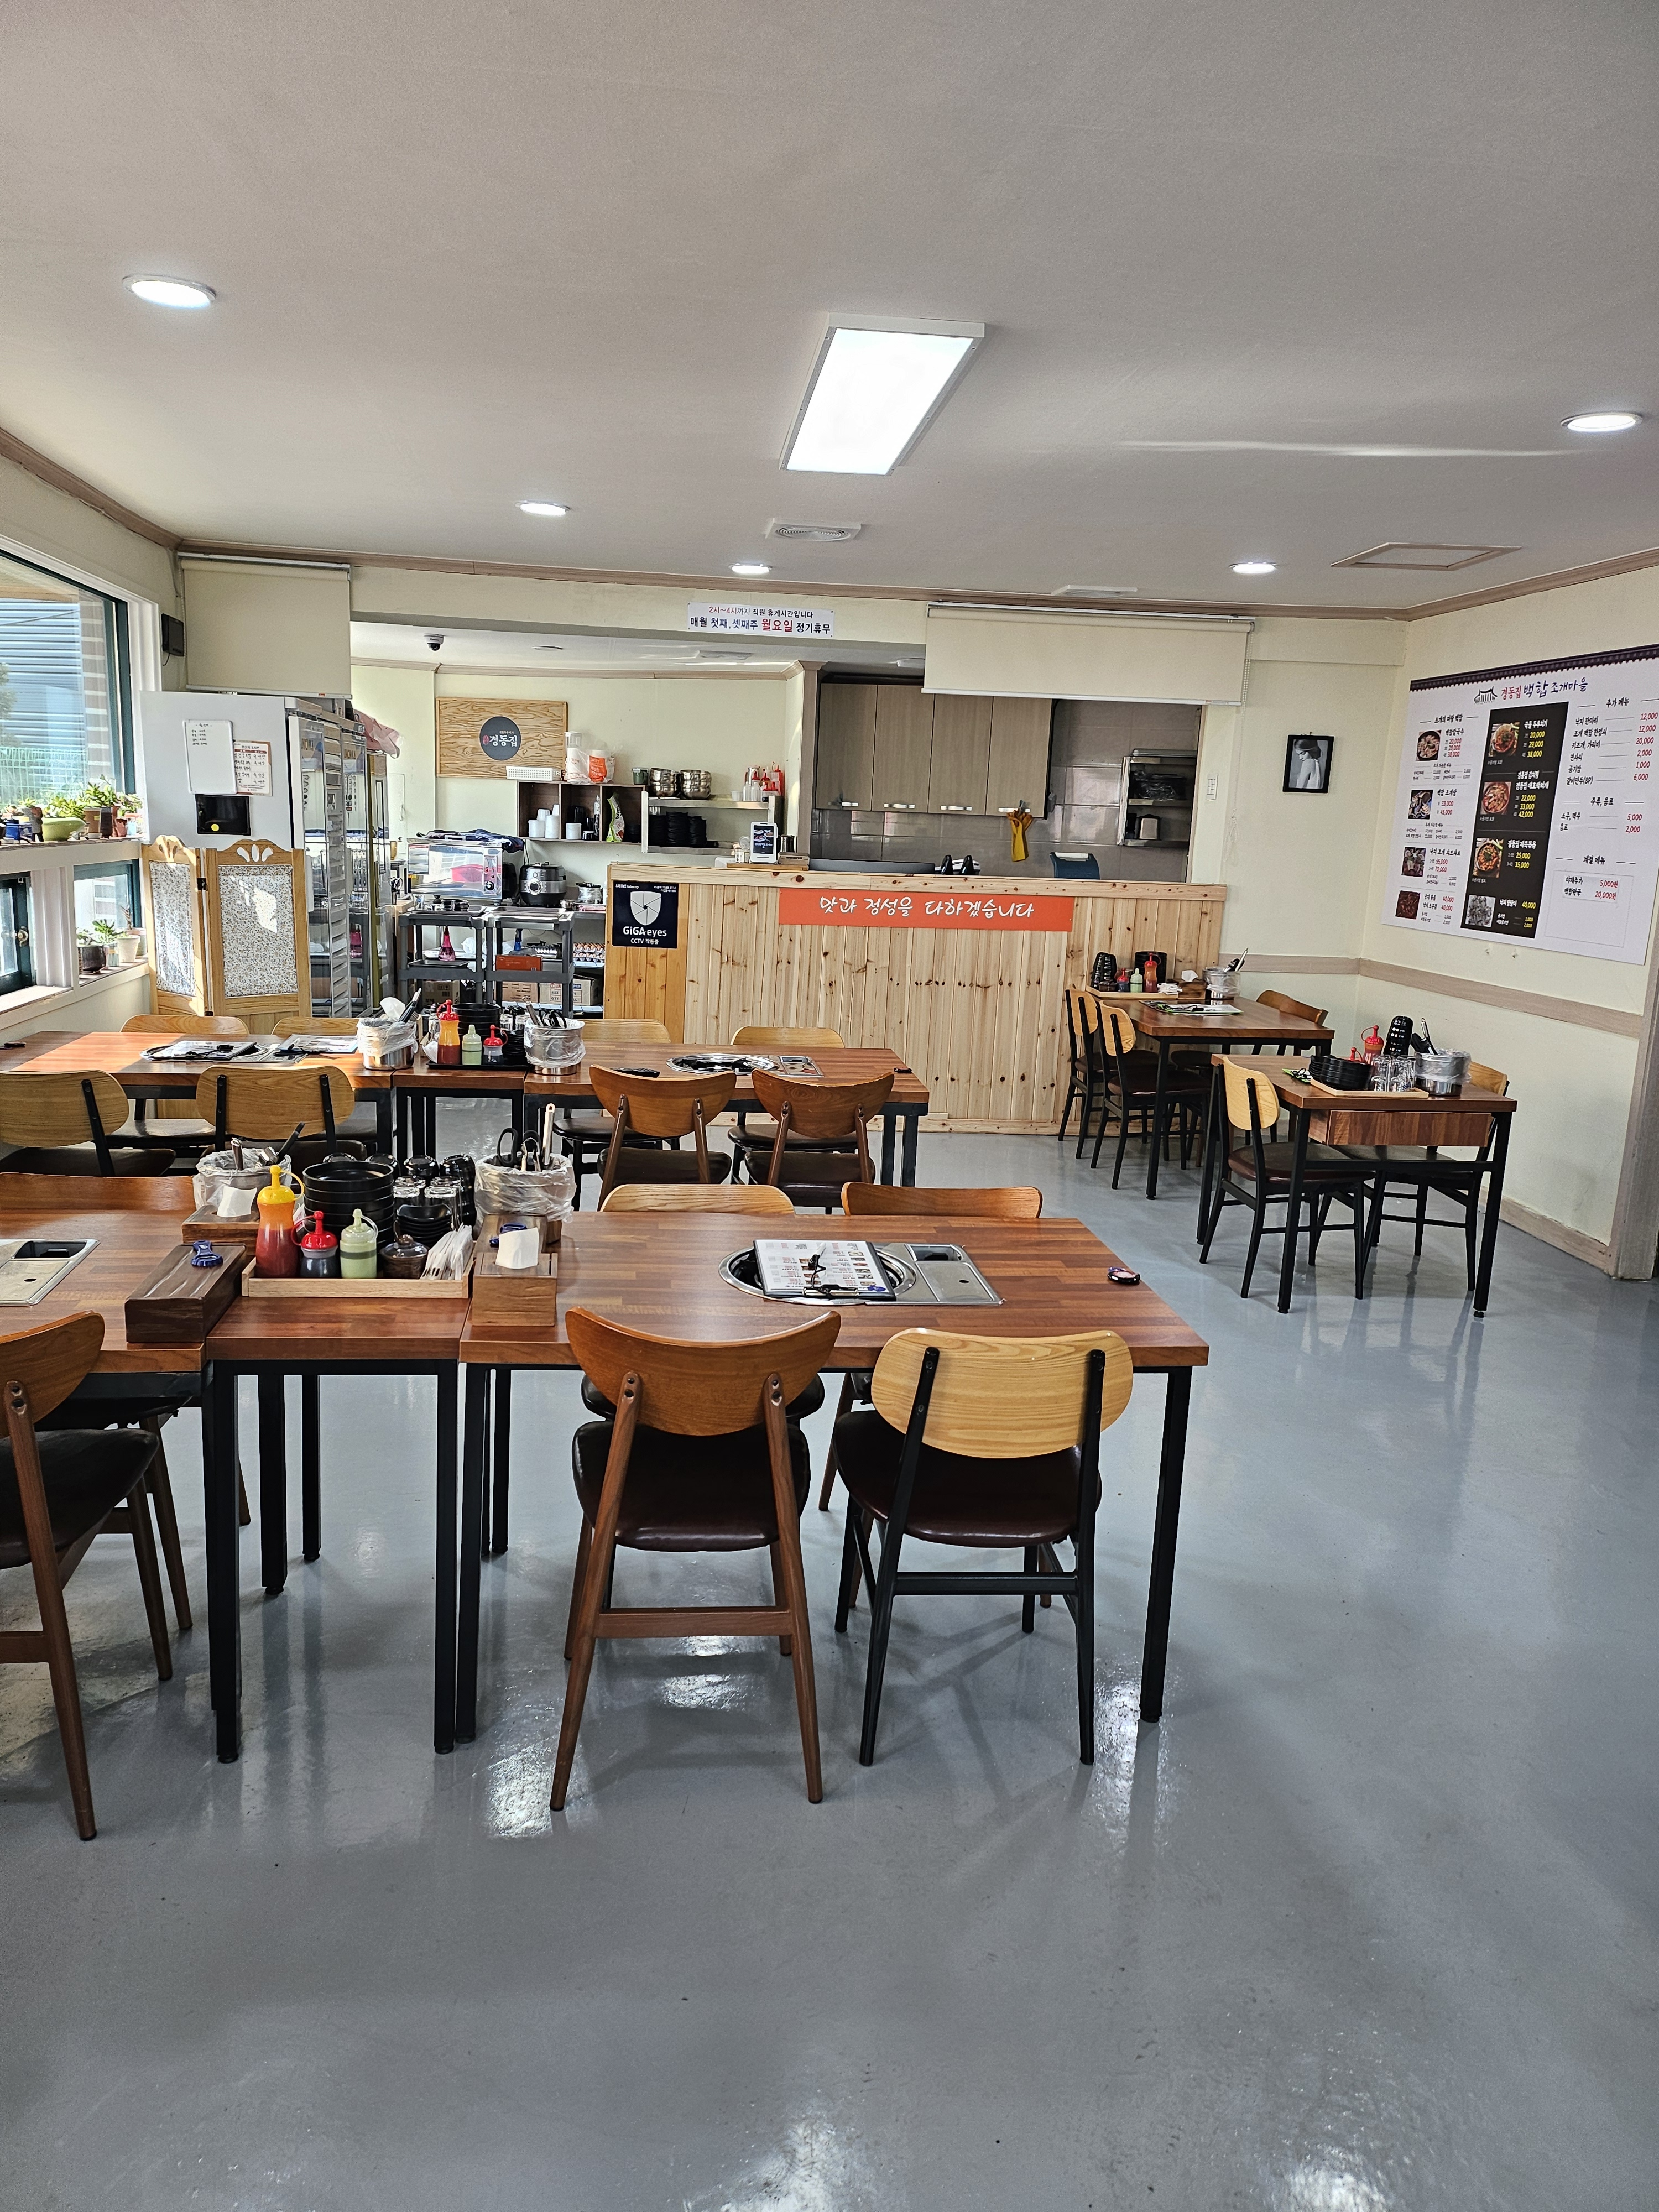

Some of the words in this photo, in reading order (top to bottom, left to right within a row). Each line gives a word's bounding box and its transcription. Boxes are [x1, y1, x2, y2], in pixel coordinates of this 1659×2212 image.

[767, 609, 813, 619] 휴게시간입니다
[690, 617, 707, 628] 매월
[761, 618, 792, 633] 월요일
[796, 622, 831, 634] 정기휴무
[1501, 686, 1521, 700] 경동집
[1524, 680, 1548, 698] 백합
[1551, 677, 1588, 693] 조개마을
[1606, 698, 1618, 708] 추가
[1618, 697, 1630, 706] 메뉴
[1575, 717, 1584, 726] 낙지
[1585, 716, 1599, 725] 한마리
[1640, 712, 1658, 721] 12,000
[1638, 724, 1656, 734] 12,000
[489, 734, 517, 747] 경동집
[1587, 740, 1600, 749] 가리비
[1636, 737, 1654, 745] 20,000
[1637, 749, 1652, 758] 2,000
[1568, 765, 1582, 773] 공기밥
[1636, 761, 1650, 770] 1,000
[1517, 771, 1528, 779] 경동집
[1634, 773, 1648, 781] 6,000
[1516, 781, 1527, 790] 경동집
[1604, 797, 1614, 806] 음료
[1572, 812, 1581, 820] 맥주
[1508, 840, 1520, 848] 경동집
[1583, 855, 1593, 864] 계절
[1594, 855, 1605, 865] 메뉴
[1600, 880, 1618, 889] 5,000원
[1595, 891, 1616, 900] 20,000원
[819, 896, 857, 914] 맛과
[864, 896, 913, 917] 정성을
[925, 898, 1035, 919] 다하겠습니다
